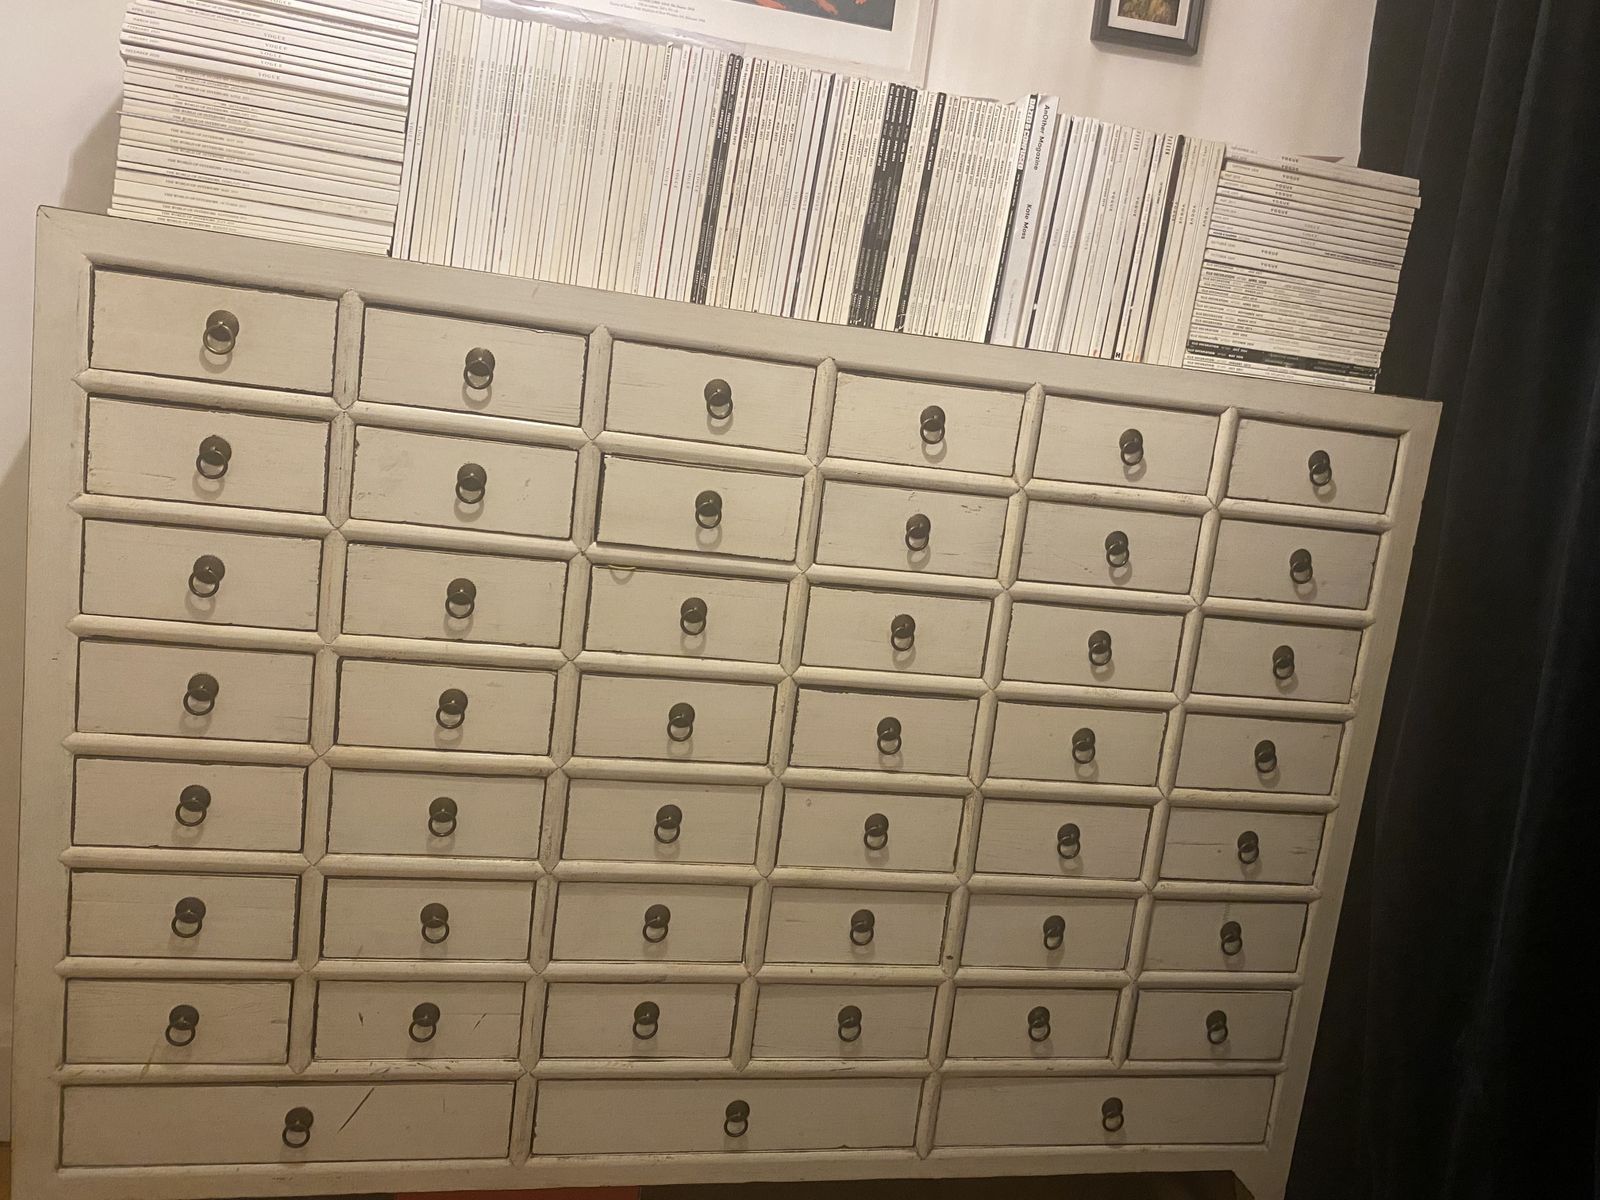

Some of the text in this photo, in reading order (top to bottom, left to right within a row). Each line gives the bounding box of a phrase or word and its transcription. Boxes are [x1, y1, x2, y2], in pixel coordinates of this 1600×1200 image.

[1025, 98, 1035, 123] DAZED
[1016, 129, 1030, 170] CONFUSED
[1020, 104, 1050, 239] AnOther Magazine Kate Moss
